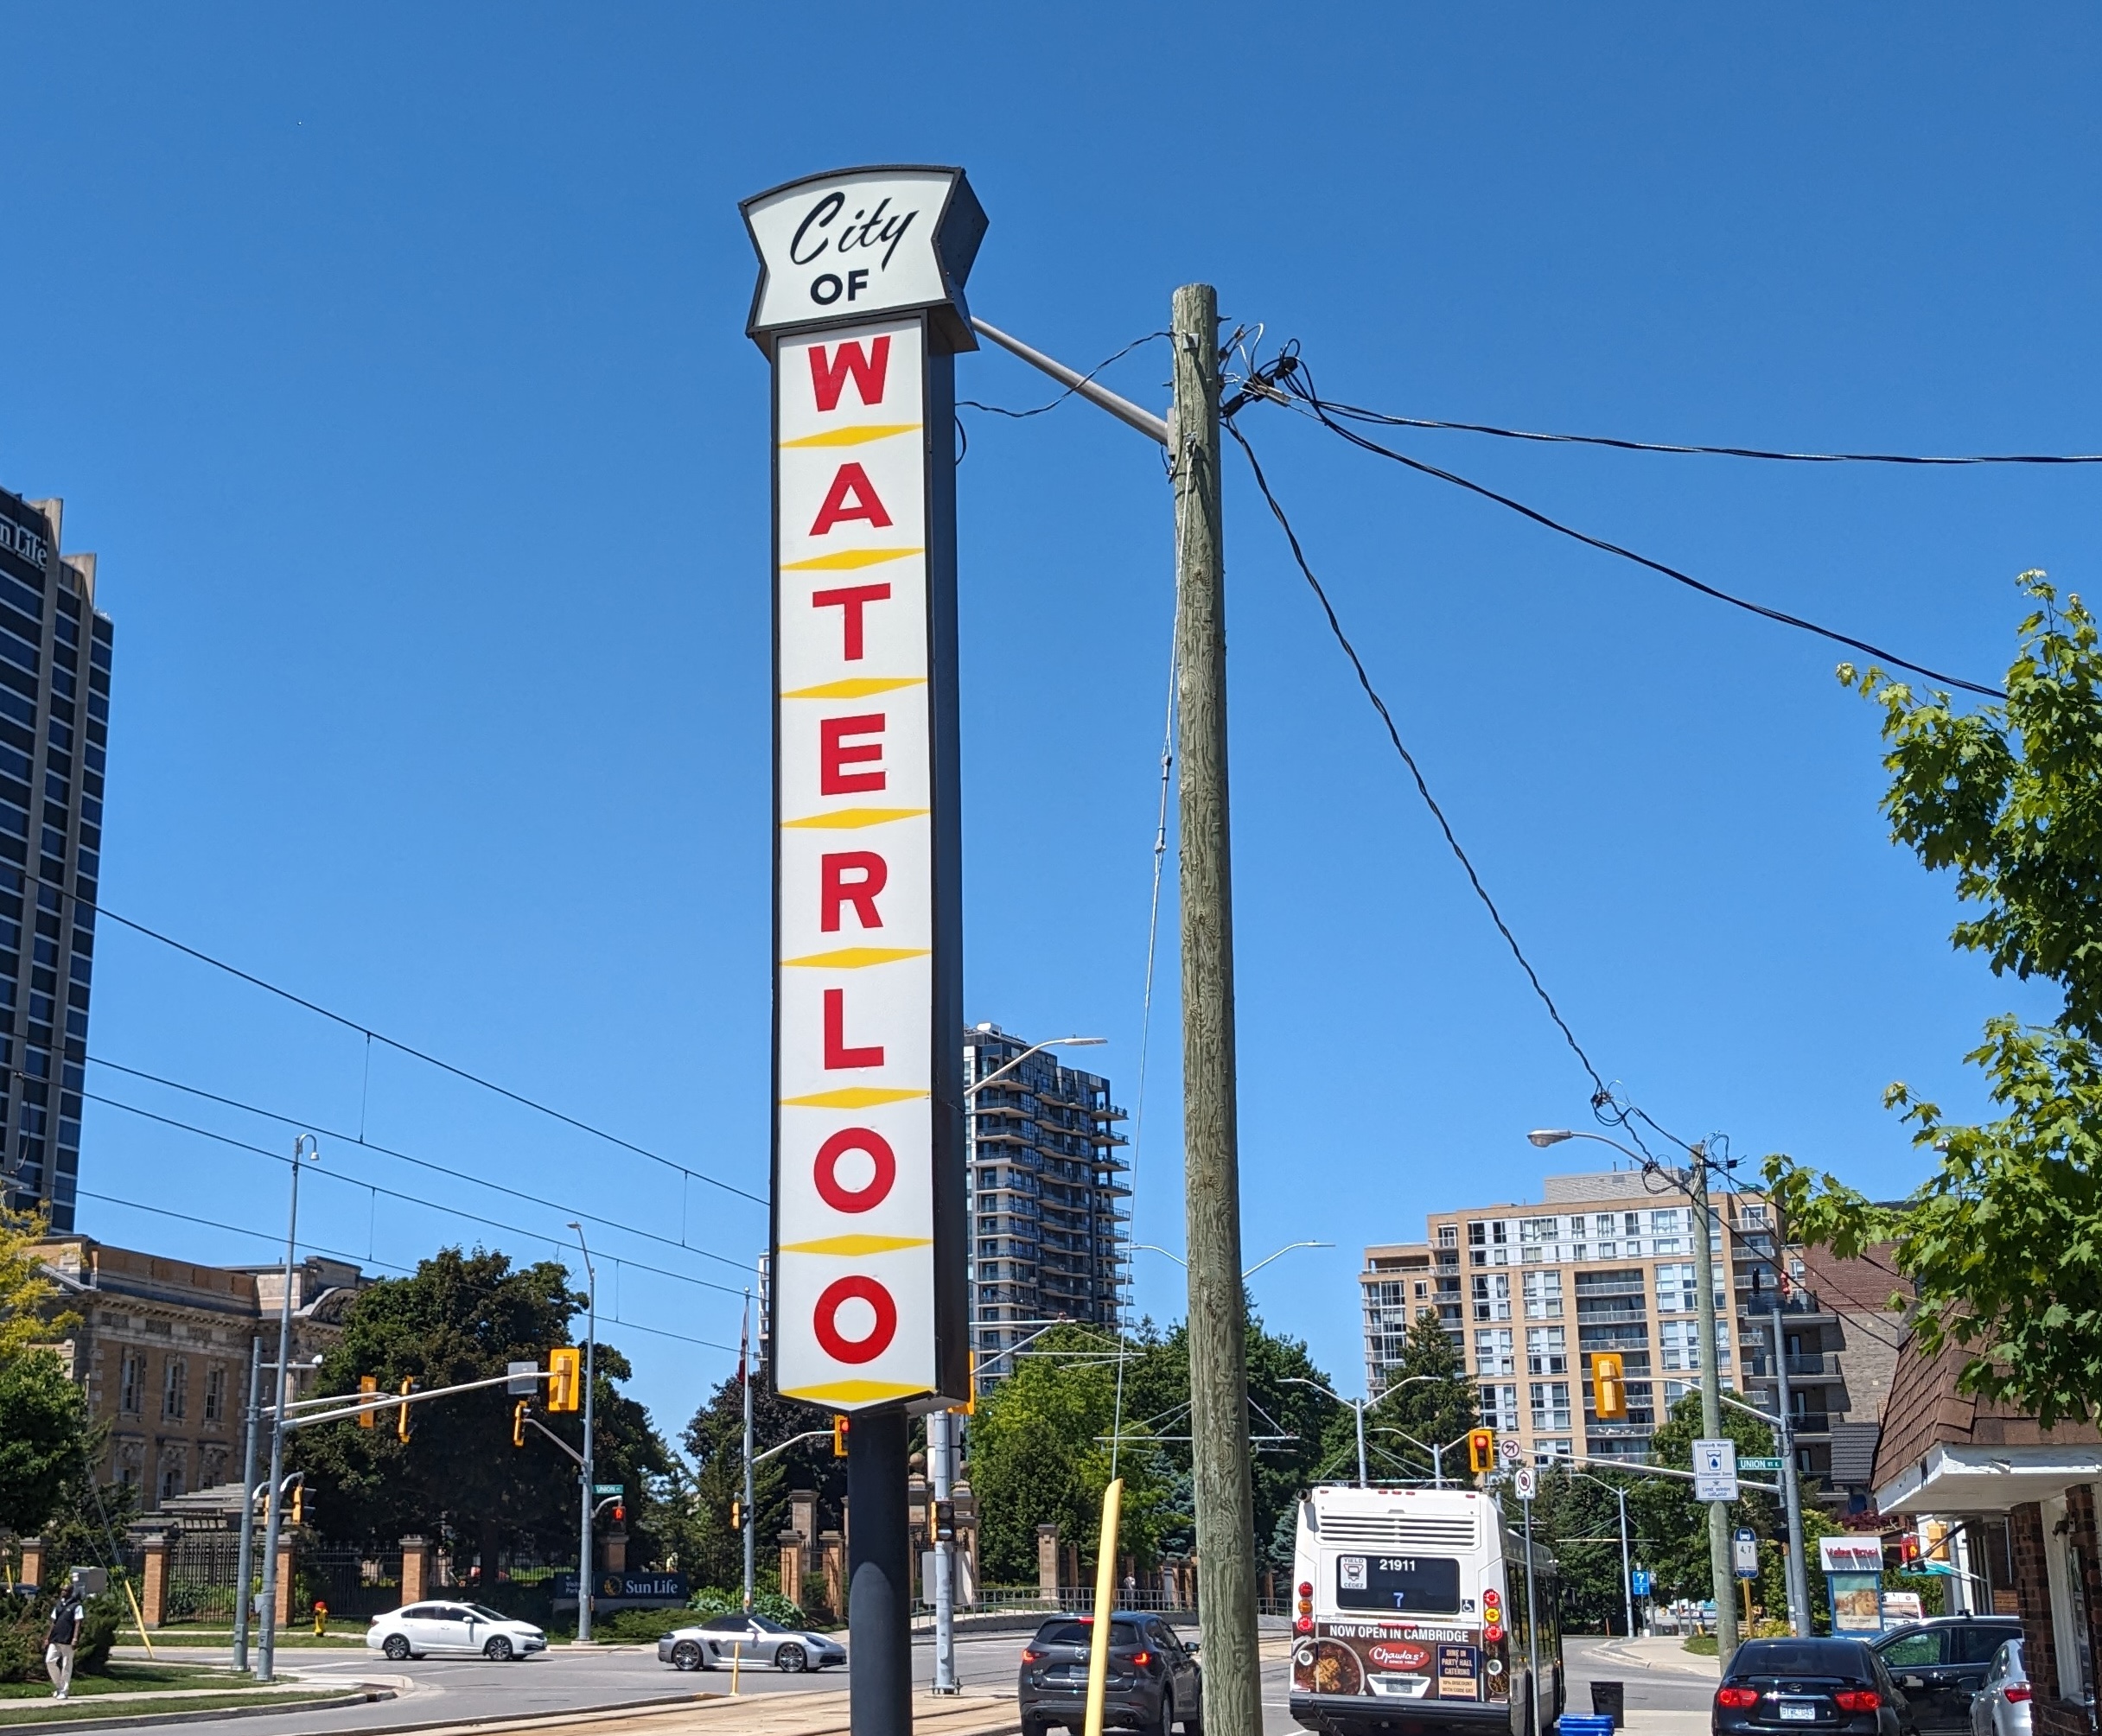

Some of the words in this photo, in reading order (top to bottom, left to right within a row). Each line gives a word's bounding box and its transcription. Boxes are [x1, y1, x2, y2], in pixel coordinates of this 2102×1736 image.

[790, 192, 919, 271] City
[810, 269, 869, 305] OF
[15, 526, 47, 567] Life
[808, 335, 896, 1364] WATERLOO
[1740, 1459, 1766, 1468] UNION
[596, 1485, 615, 1493] UNION
[1379, 1558, 1416, 1572] 21911
[625, 1580, 651, 1593] Sun
[653, 1579, 678, 1593] Life
[1392, 1592, 1405, 1608] 7
[1329, 1625, 1355, 1637] NOW
[1358, 1625, 1387, 1639] OPEN
[1389, 1628, 1401, 1640] IN
[1404, 1628, 1469, 1643] CAMBRIDGE
